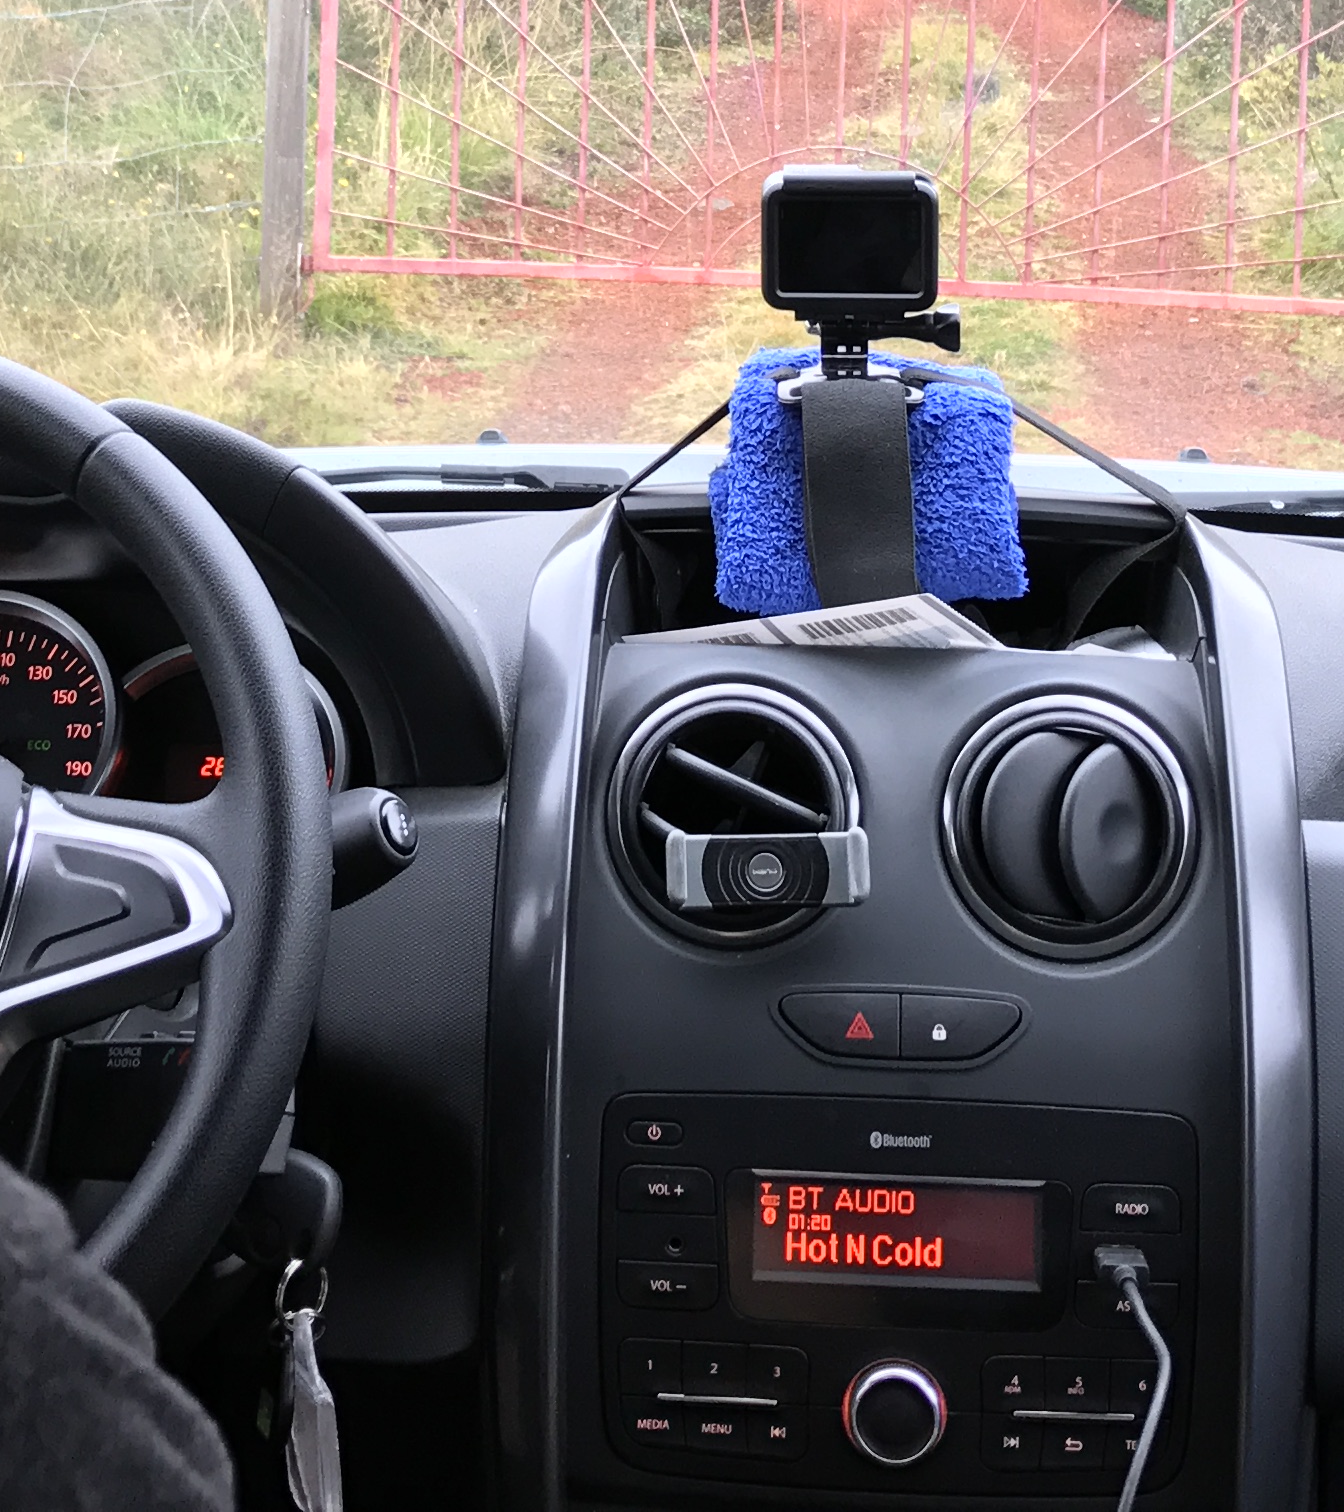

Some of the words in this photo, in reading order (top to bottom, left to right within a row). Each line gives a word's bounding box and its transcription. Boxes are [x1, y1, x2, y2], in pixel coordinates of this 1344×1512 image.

[27, 666, 53, 680] 130
[52, 690, 78, 705] 150
[65, 724, 92, 739] 170
[27, 739, 51, 751] ECO
[64, 761, 92, 777] 190
[108, 1047, 142, 1057] SOURCE
[106, 1058, 141, 1067] AUDIO
[882, 1133, 931, 1148] Bluetooth
[648, 1183, 671, 1196] VOL
[788, 1186, 824, 1211] BT
[834, 1188, 915, 1214] AUDIO
[1115, 1202, 1149, 1215] RADIO
[788, 1213, 831, 1231] 01:20
[784, 1231, 839, 1264] Hot
[846, 1234, 865, 1265] N
[872, 1234, 944, 1268] Cold
[650, 1279, 673, 1292] VOL
[1116, 1300, 1131, 1312] AS
[647, 1359, 653, 1371] 1
[710, 1363, 719, 1374] 2
[773, 1366, 781, 1377] 3
[1011, 1374, 1019, 1386] 4
[1075, 1376, 1083, 1387] 5
[1138, 1379, 1147, 1391] 6
[637, 1418, 670, 1431] MEDIA
[701, 1422, 733, 1435] MENU
[1125, 1439, 1138, 1450] TE
